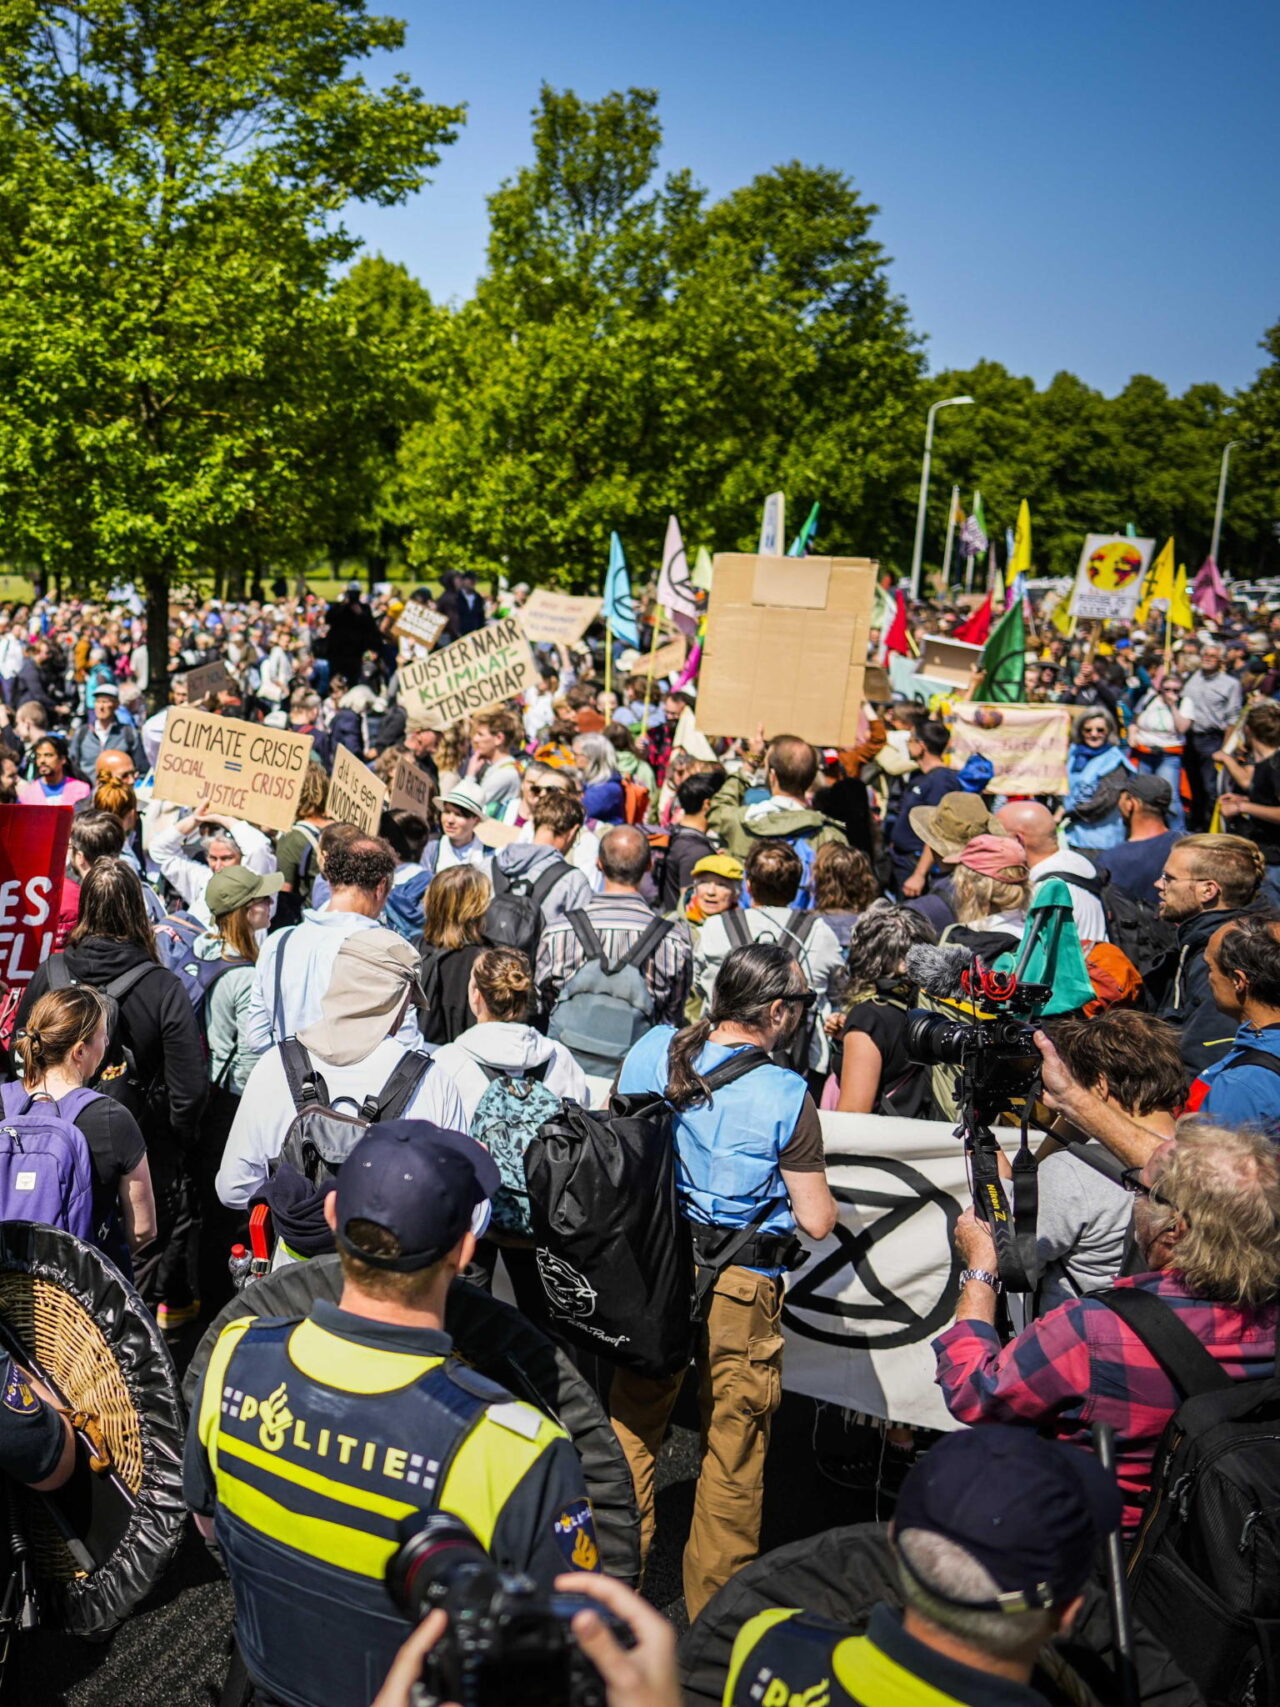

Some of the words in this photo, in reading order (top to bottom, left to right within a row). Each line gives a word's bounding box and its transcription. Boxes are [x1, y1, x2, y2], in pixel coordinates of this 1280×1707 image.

[402, 642, 472, 689] LUISTER
[471, 618, 520, 658] NAAR
[169, 718, 247, 758] CLIMATE
[249, 737, 304, 771] CRISIS
[162, 753, 206, 779] SOCIAL
[251, 772, 297, 800] CRISIS
[197, 781, 249, 810] JUSTICE
[239, 1382, 410, 1481] POLITIE
